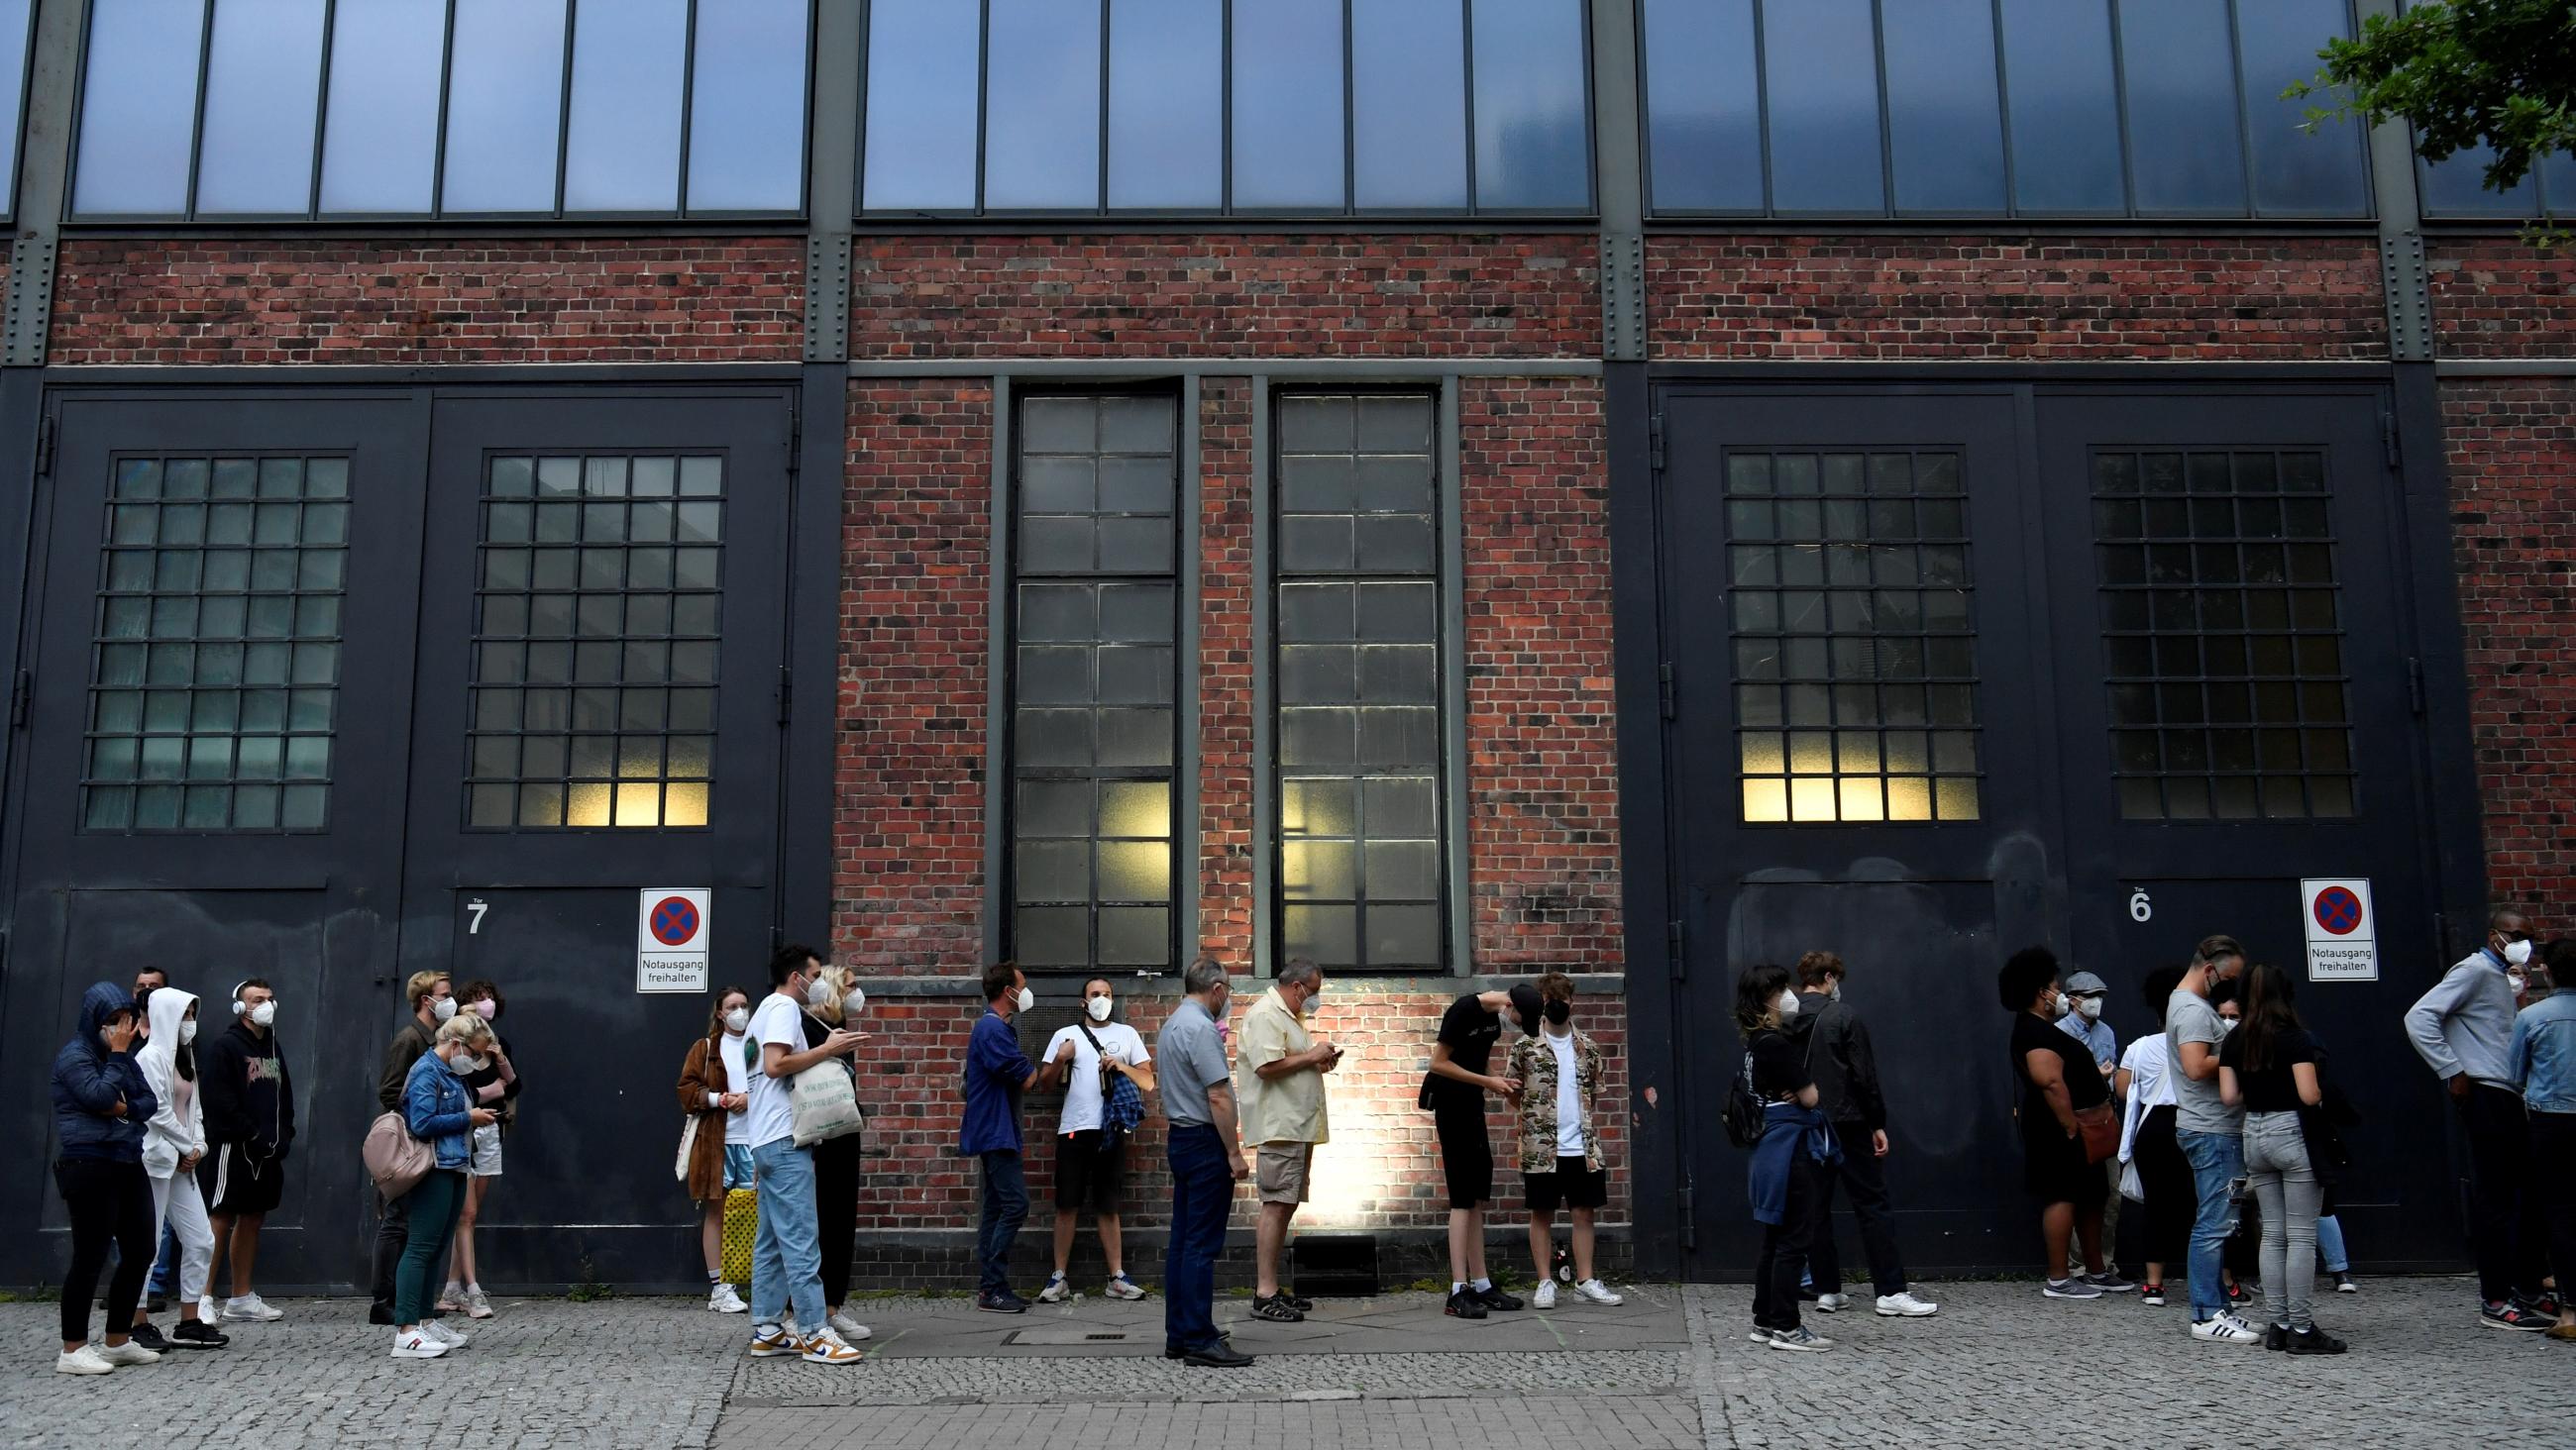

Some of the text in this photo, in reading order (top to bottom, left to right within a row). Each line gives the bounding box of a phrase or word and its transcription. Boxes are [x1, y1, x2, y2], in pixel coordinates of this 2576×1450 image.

[2130, 892, 2152, 922] 6
[468, 903, 488, 934] 7
[2311, 948, 2372, 960] Notausgang
[642, 960, 703, 972] Notausgang
[2319, 961, 2367, 972] freihalten
[648, 973, 697, 983] freihalten
